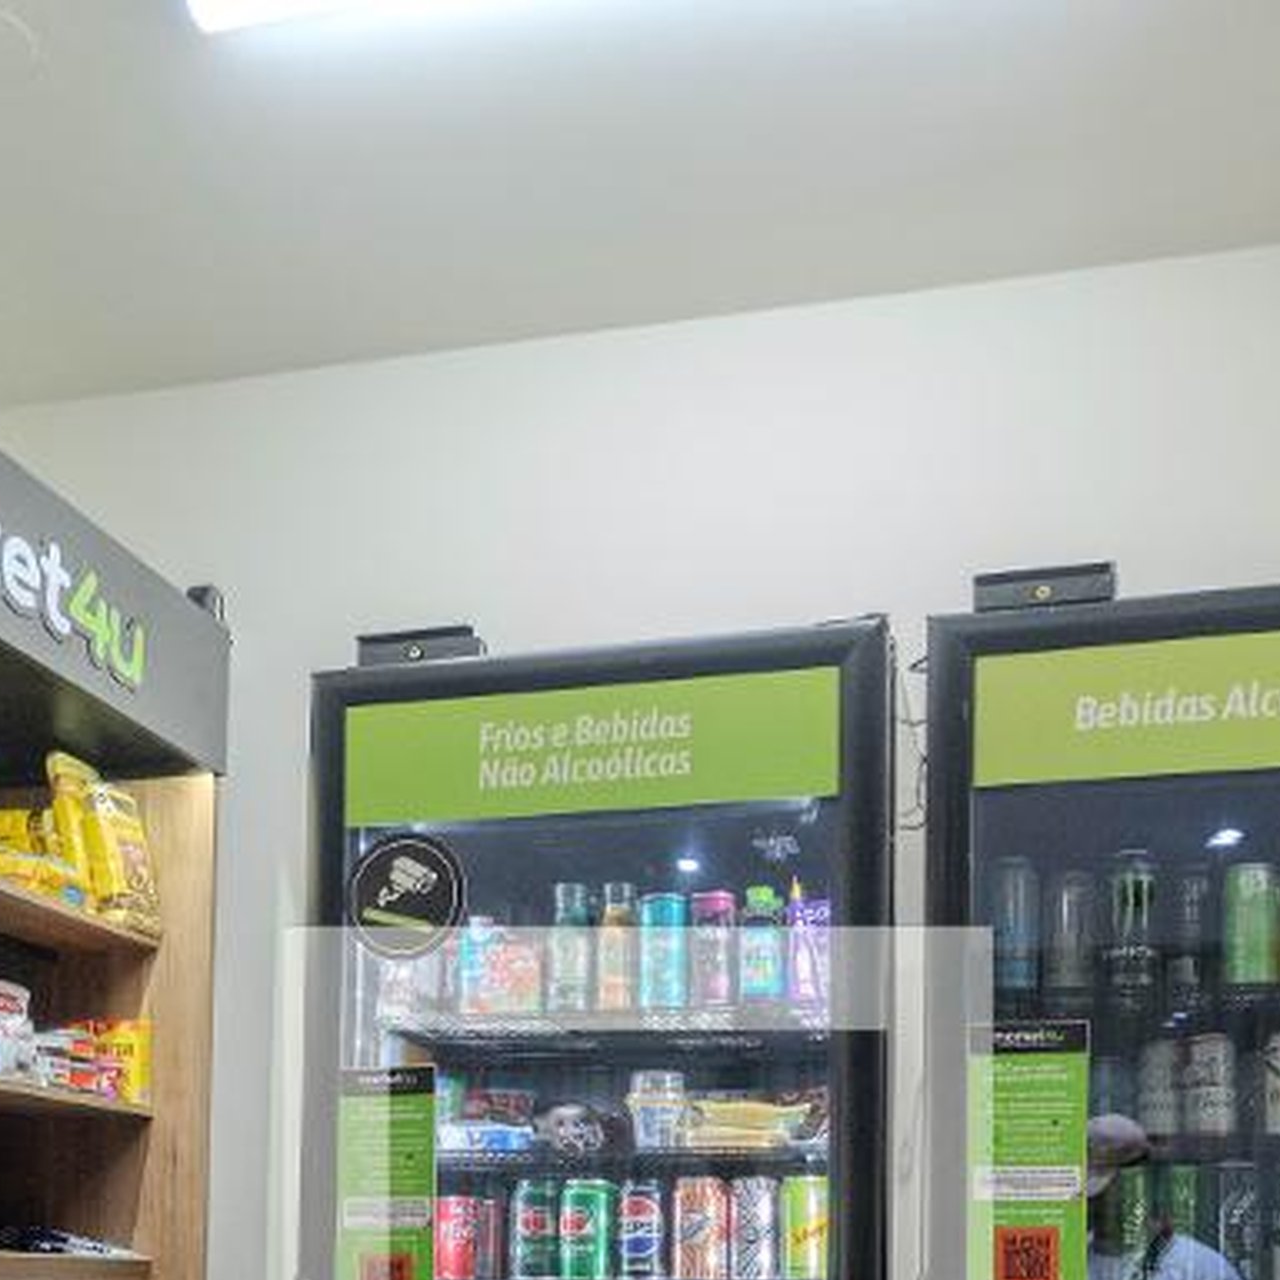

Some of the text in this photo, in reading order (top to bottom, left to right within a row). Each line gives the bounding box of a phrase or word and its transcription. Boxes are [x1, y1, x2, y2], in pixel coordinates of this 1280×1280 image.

[479, 706, 694, 754] Frios e Bebidas
[1075, 690, 1217, 731] Bebidas
[479, 748, 693, 790] Não Alcoólicas
